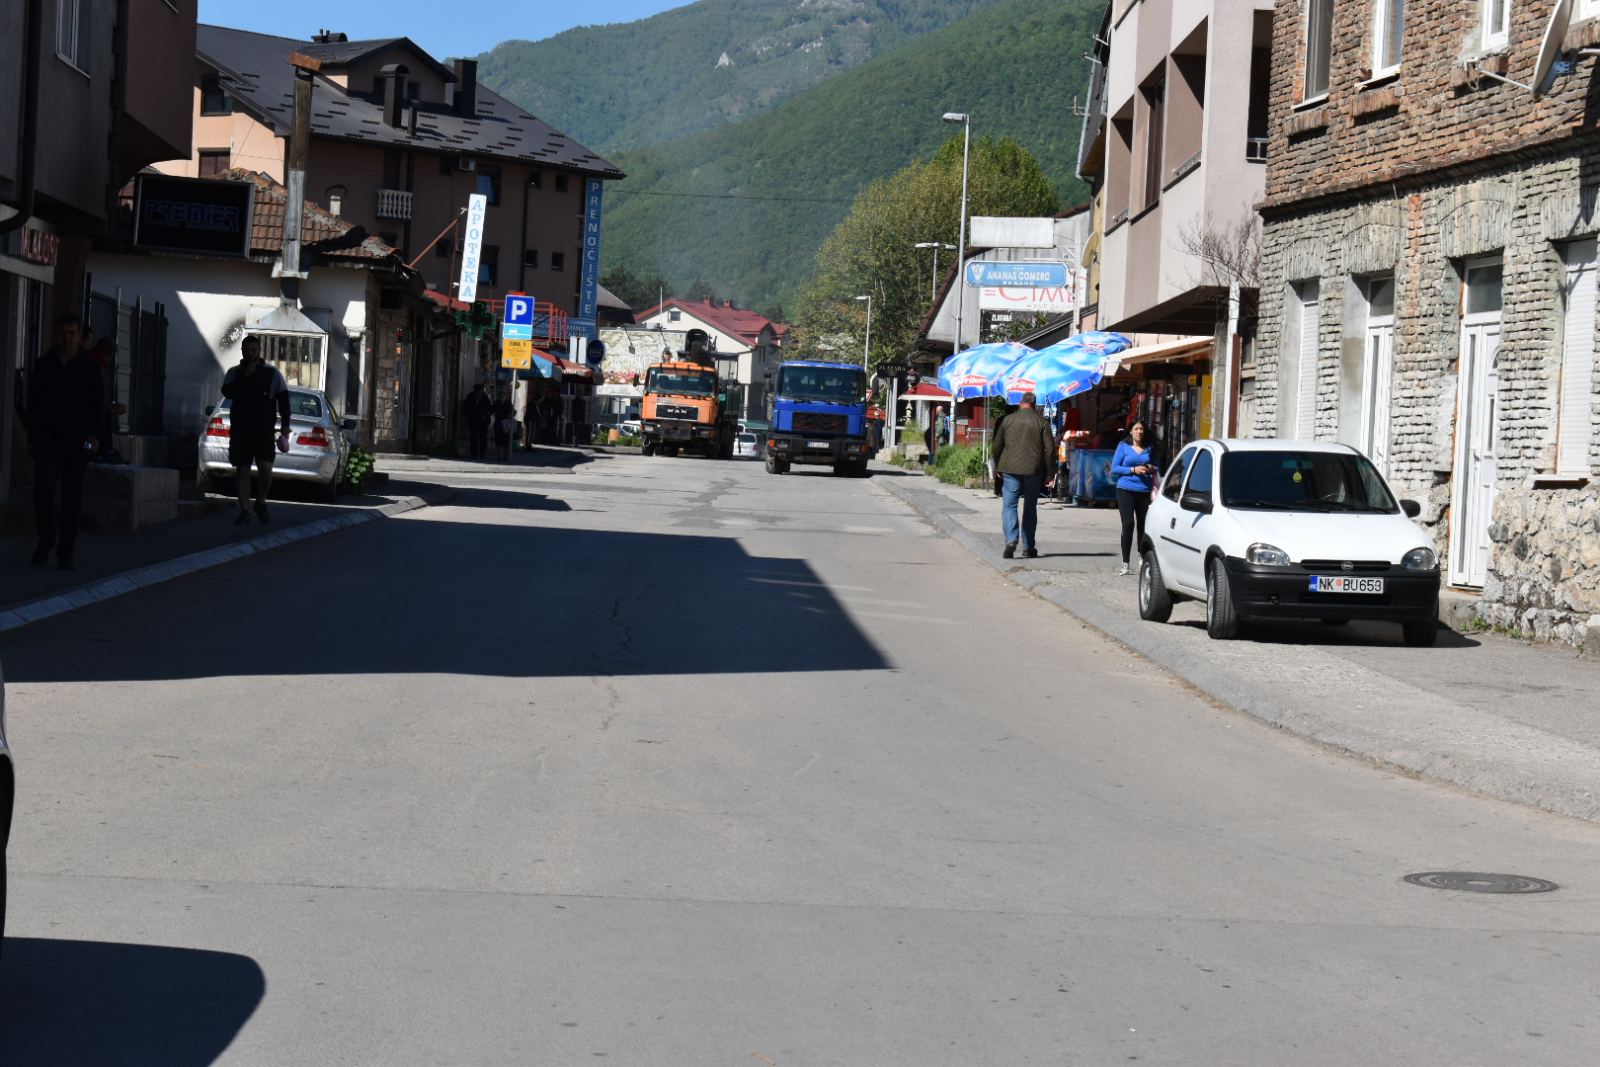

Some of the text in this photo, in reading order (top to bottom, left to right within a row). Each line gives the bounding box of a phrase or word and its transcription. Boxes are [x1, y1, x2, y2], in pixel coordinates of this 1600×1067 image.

[144, 198, 241, 232] PREMIER
[461, 199, 483, 297] APOTEKA
[511, 299, 527, 321] P
[1319, 577, 1335, 591] NK
[1343, 579, 1382, 592] BU653
